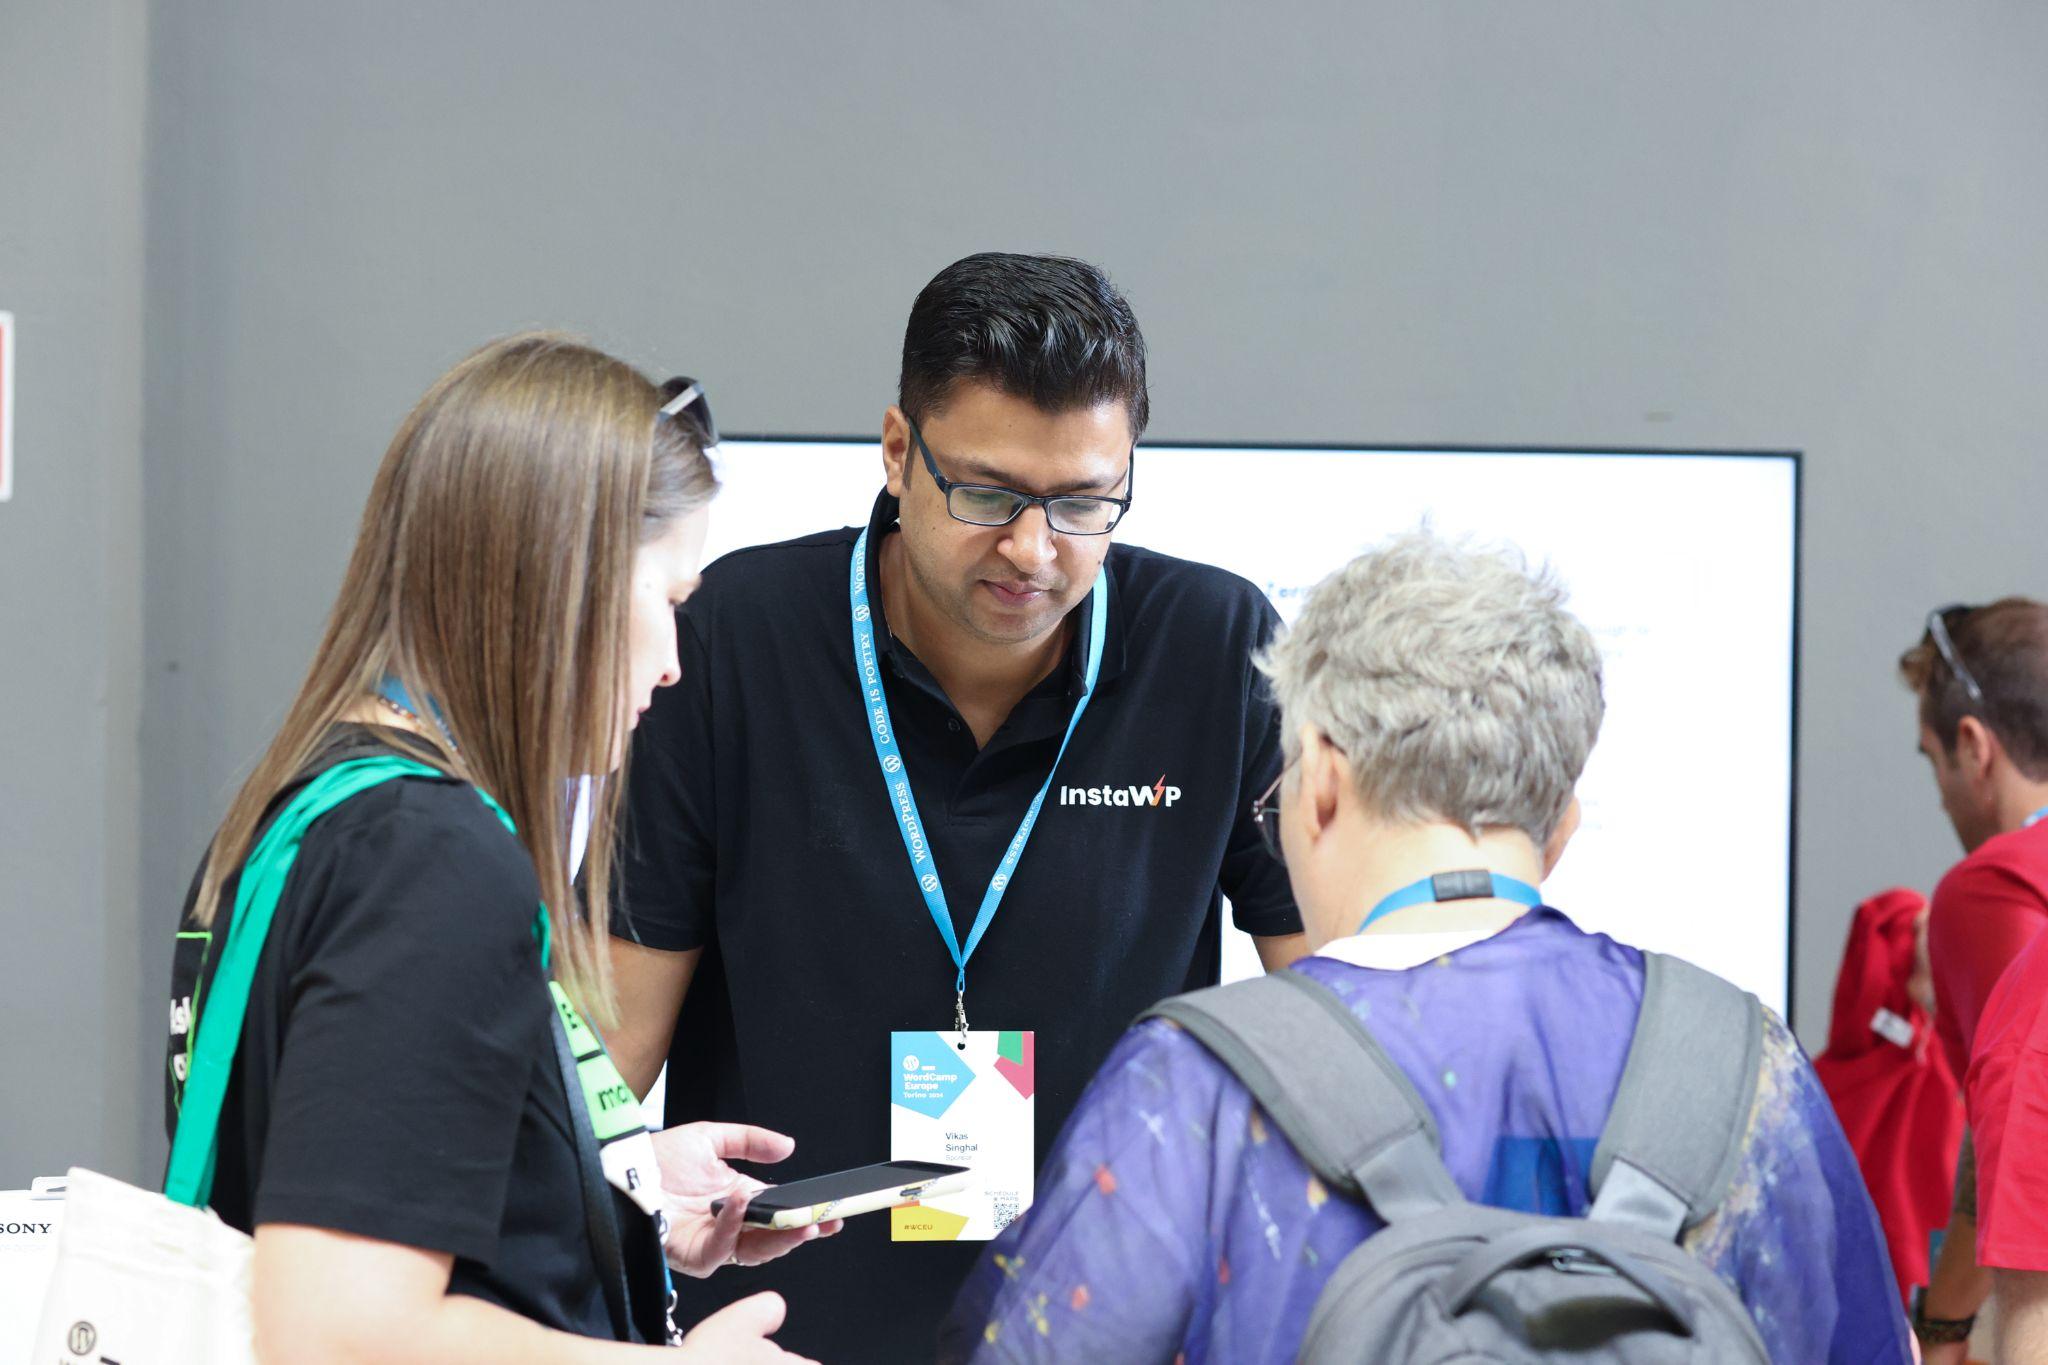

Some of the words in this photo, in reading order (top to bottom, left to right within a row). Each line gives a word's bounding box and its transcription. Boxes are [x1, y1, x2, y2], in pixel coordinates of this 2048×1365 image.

[860, 633, 877, 686] POETRY
[870, 688, 881, 702] IS
[874, 706, 890, 744] CODE
[1060, 774, 1181, 807] InstaWP
[895, 782, 926, 864] WORDPRESS
[903, 1073, 958, 1082] WordCamp
[904, 1082, 939, 1091] Europe
[903, 1091, 927, 1099] Torino
[945, 1132, 968, 1140] Vikas
[945, 1143, 978, 1153] Singhal
